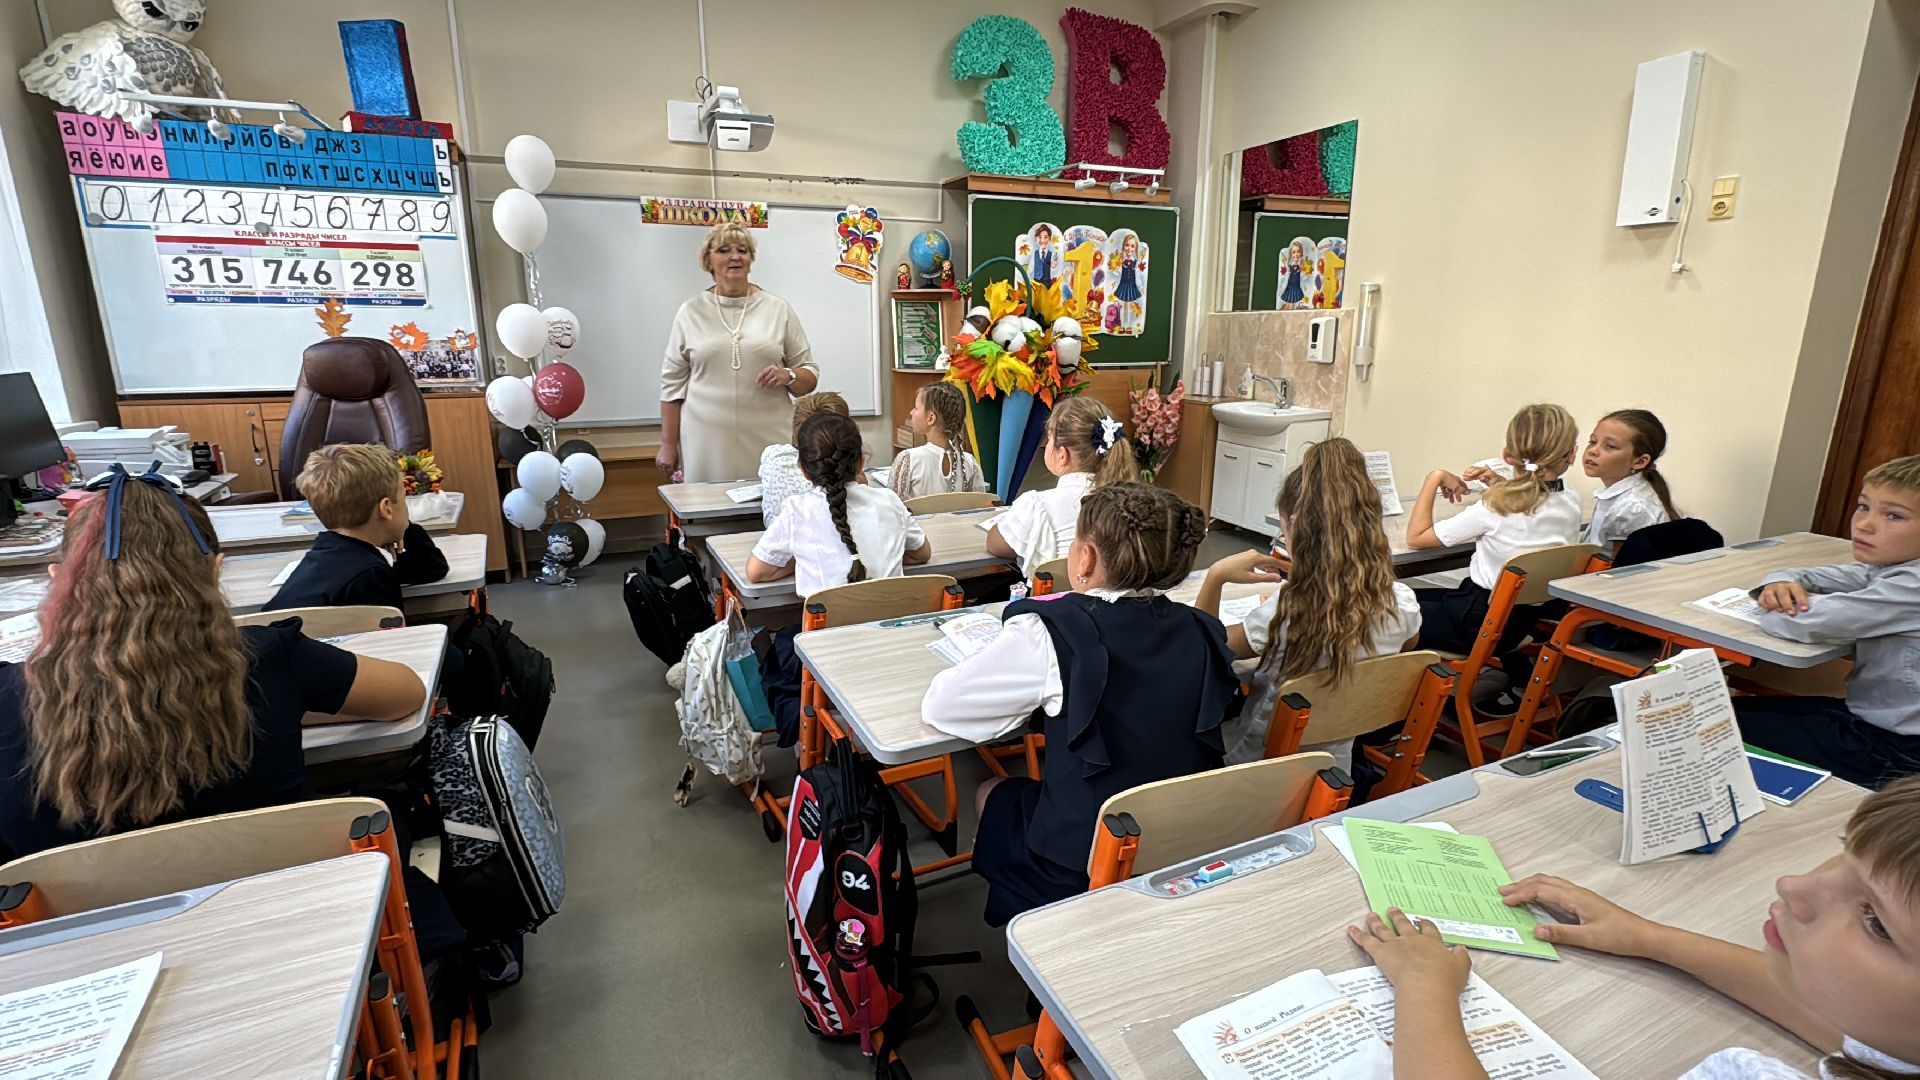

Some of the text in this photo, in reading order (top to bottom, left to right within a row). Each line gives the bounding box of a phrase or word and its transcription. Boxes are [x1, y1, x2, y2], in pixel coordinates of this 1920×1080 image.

[101, 185, 451, 233] 0 1 2 3 4 5 6 7 8 9
[658, 206, 752, 226] ШКОЛА!
[280, 232, 319, 240] РАЗРЯДЫ
[171, 256, 244, 284] 315
[263, 259, 333, 286] 746
[350, 261, 415, 287] 298
[1064, 241, 1094, 318] 1
[842, 870, 871, 891] 94
[1244, 1027, 1251, 1035] О
[1279, 1003, 1305, 1019] Родине
